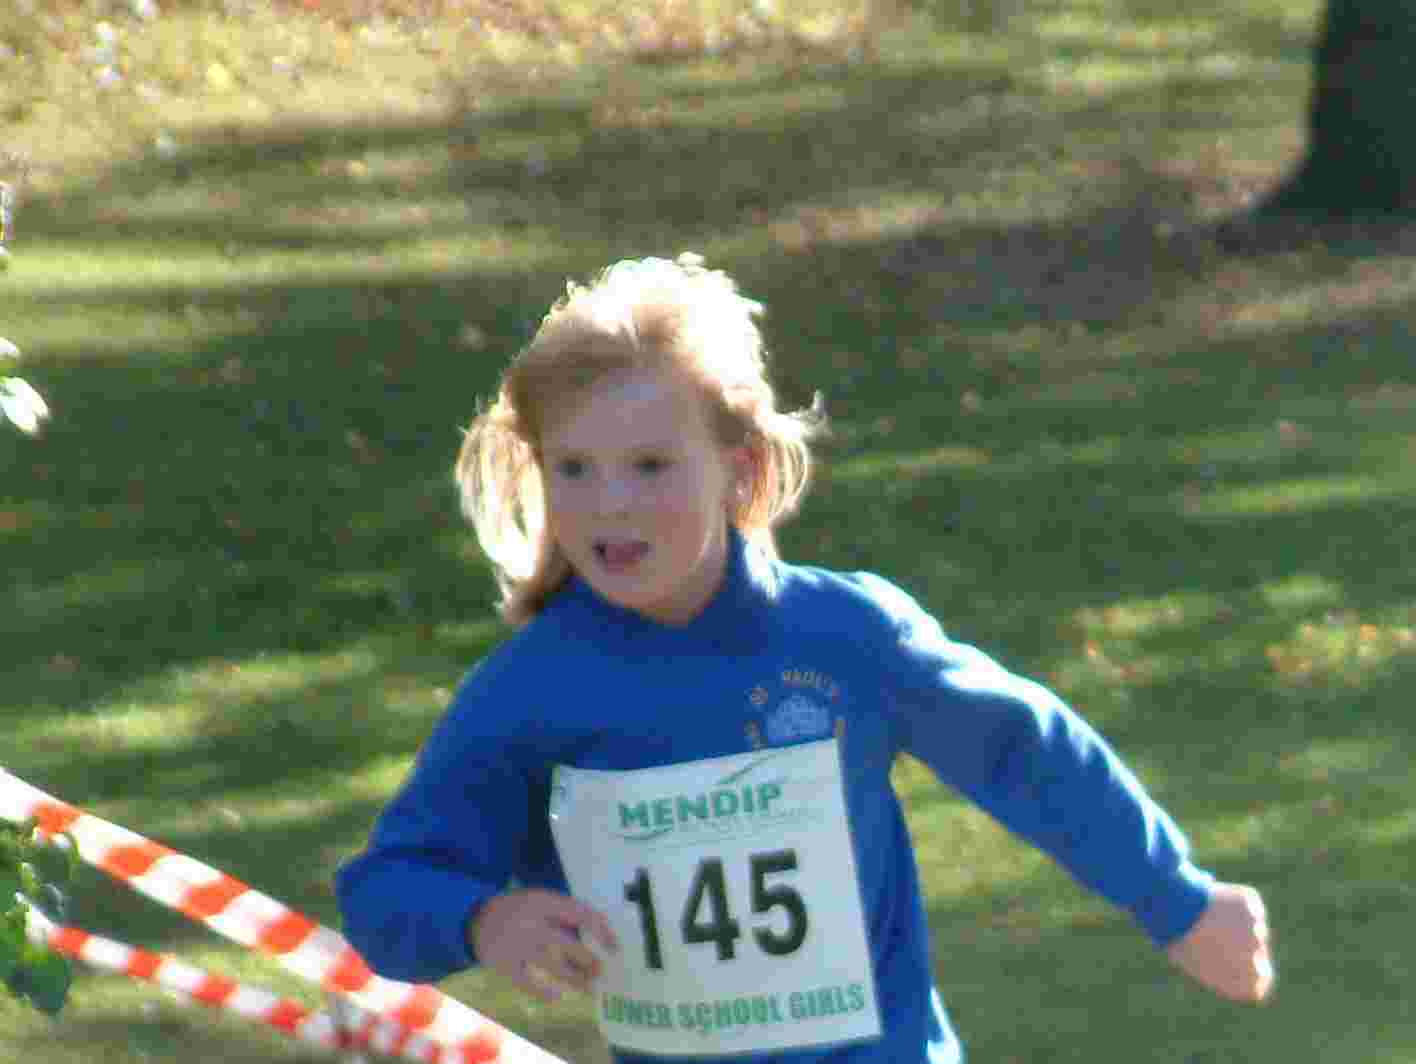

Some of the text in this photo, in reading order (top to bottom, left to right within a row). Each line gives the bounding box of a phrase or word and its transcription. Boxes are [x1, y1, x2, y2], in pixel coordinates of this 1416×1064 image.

[617, 784, 782, 830] MENDIP
[624, 848, 808, 970] 145
[681, 999, 783, 1032] SCHOOL
[789, 984, 866, 1020] GIRLS
